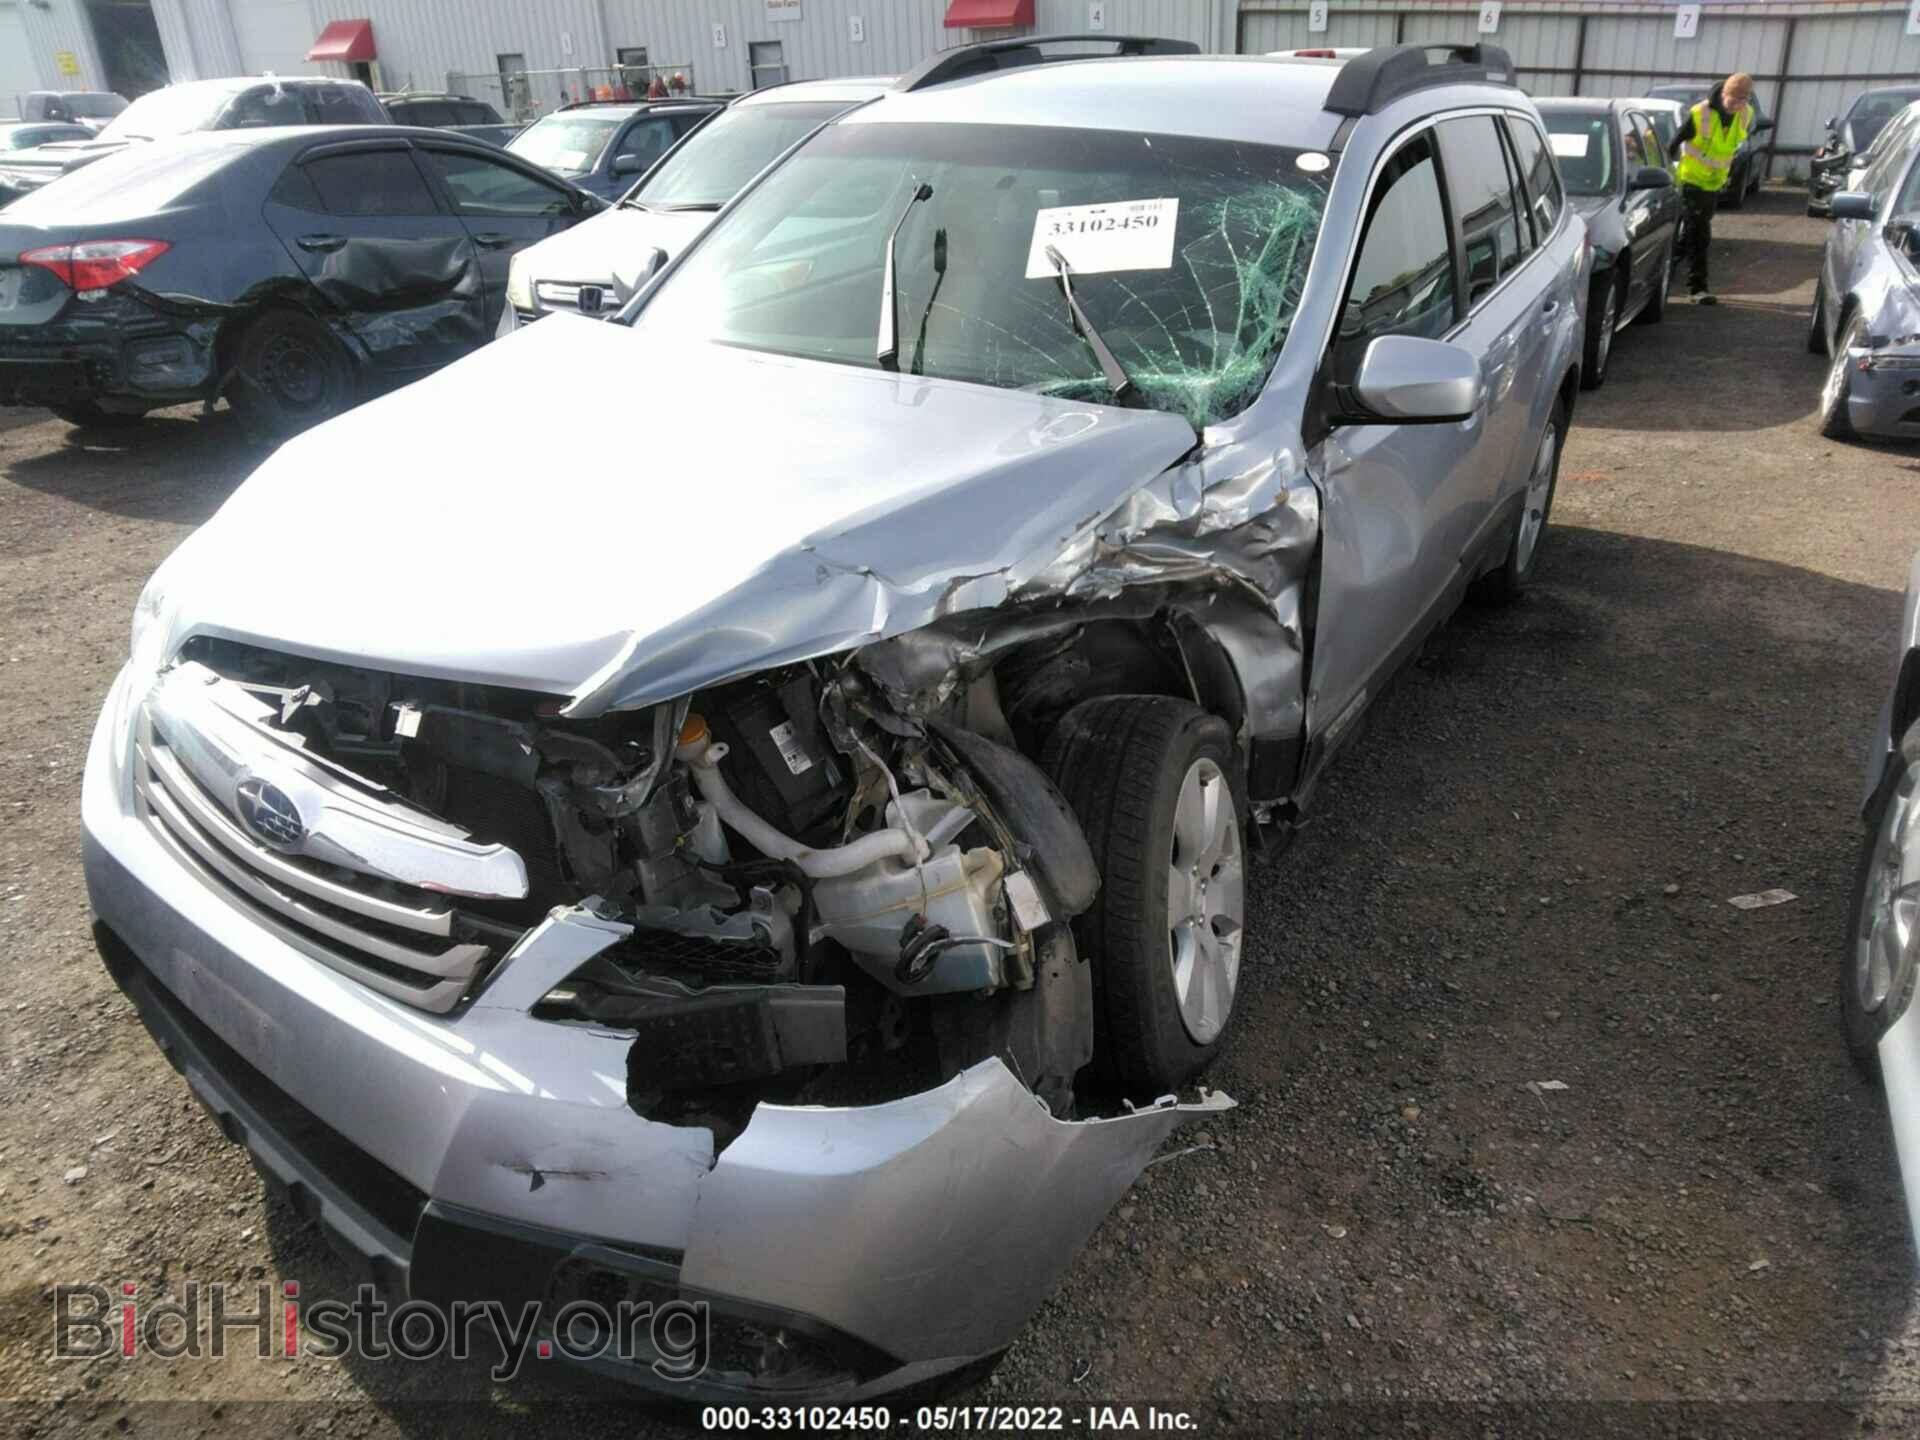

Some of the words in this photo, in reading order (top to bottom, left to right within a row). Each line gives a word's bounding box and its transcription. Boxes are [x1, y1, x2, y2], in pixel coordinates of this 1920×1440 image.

[1314, 9, 1322, 23] 5
[1484, 10, 1493, 24] 6
[1683, 13, 1692, 28] 7
[1048, 215, 1159, 236] 33102450
